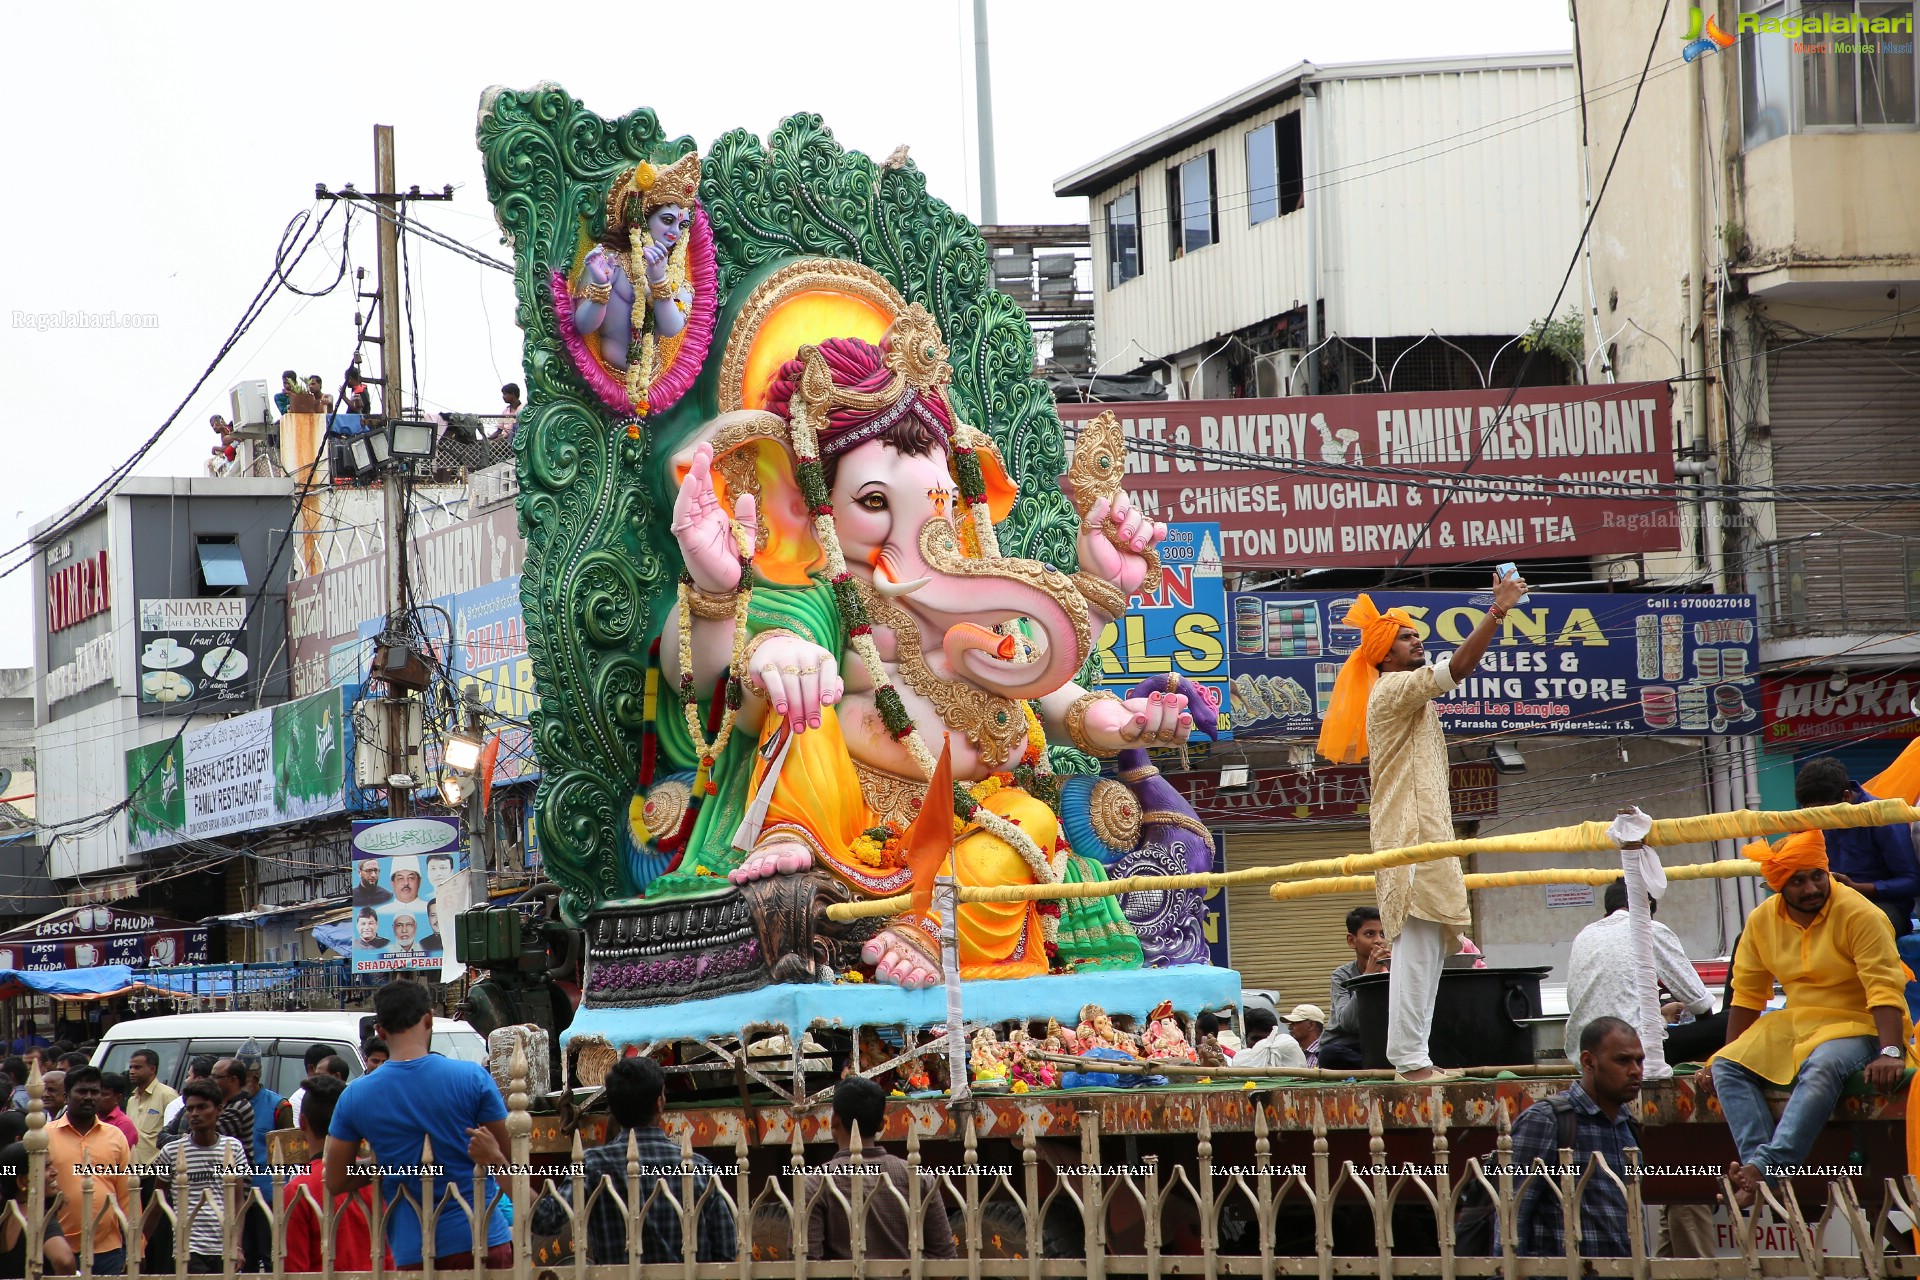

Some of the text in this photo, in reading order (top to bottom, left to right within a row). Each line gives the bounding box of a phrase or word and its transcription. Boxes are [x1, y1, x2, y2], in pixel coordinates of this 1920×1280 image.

[1121, 417, 1167, 474] AFE
[1174, 424, 1193, 473] &
[1201, 412, 1308, 472] BAKERY
[1376, 406, 1473, 465] FAMILY
[1479, 398, 1657, 462] RESTAURANT
[1128, 489, 1160, 516] AN
[1180, 486, 1288, 518] CHINESE,
[1294, 482, 1398, 511] MUGHLAI
[1406, 478, 1422, 507] &
[1558, 468, 1660, 496] CHICKEN
[1169, 529, 1193, 544] Shop
[1219, 515, 1577, 557] TTON DUM BIRYANI & IRANI TEA
[1163, 546, 1194, 559] 3009
[324, 562, 381, 639] FARASHA
[425, 522, 483, 602] BAKERY
[1128, 565, 1195, 609] AN
[48, 551, 111, 632] NIMRA
[165, 601, 242, 616] NIMRAH
[1646, 598, 1667, 609] Cell
[1680, 598, 1752, 609] 9700027018
[193, 617, 243, 628] BAKERY
[1400, 605, 1609, 647] SONA
[189, 632, 212, 645] Irani
[1097, 612, 1224, 674] RLS
[1560, 651, 1579, 673] &
[458, 658, 541, 726] PEAR
[1441, 677, 1628, 702] HING STORE
[1774, 679, 1920, 718] MUSKA
[1432, 700, 1571, 719] Special Lac Bangles
[1454, 719, 1498, 730] Farasha
[1501, 720, 1548, 731] Complex
[186, 747, 270, 791] FARASHA CAFE & BAKERY
[1450, 768, 1496, 789] CKERY
[194, 790, 217, 818] FAMILY
[218, 778, 262, 812] RESTAURANT
[35, 916, 154, 937] LASSI FALUDA
[32, 943, 57, 953] LASSI
[112, 938, 138, 948] LASSI
[40, 954, 49, 962] &
[121, 947, 130, 956] &
[27, 962, 62, 972] FALUDA
[109, 955, 143, 966] FALUDA
[357, 959, 407, 971] SHADAAN
